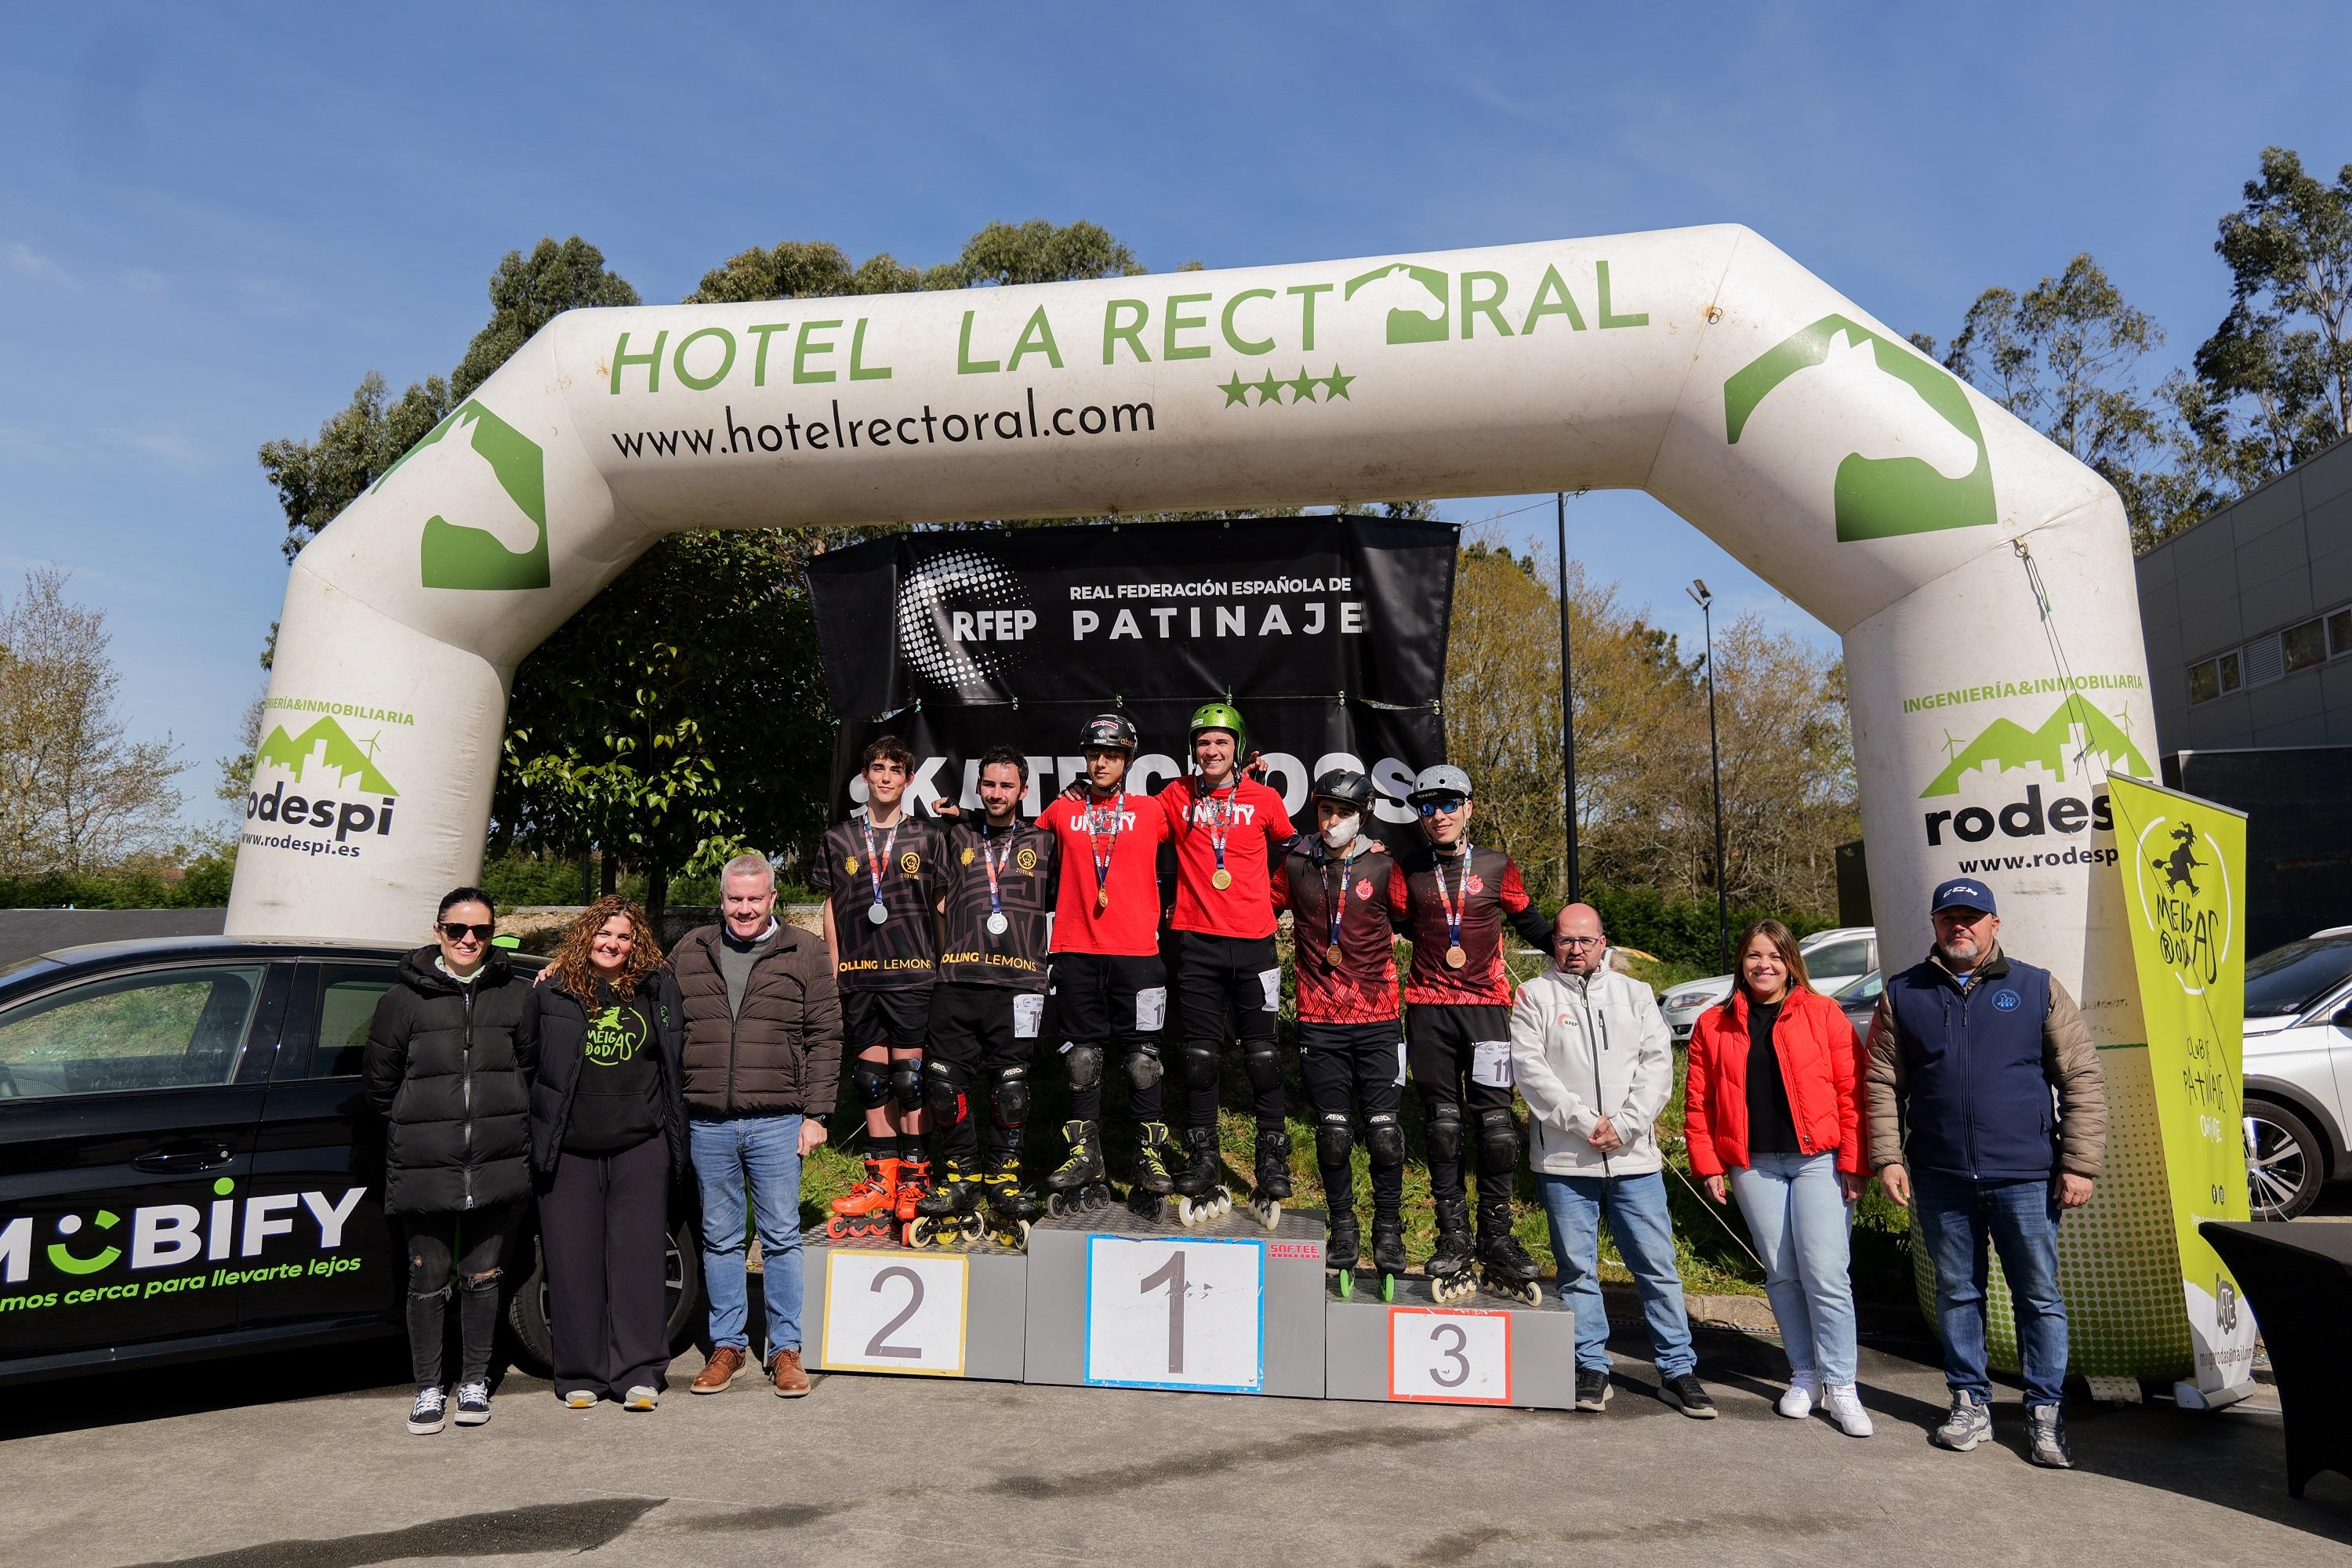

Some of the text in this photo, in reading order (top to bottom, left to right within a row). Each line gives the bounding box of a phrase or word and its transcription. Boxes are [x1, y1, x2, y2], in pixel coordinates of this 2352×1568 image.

[610, 318, 892, 395] HOTEL
[957, 303, 1064, 375] LA
[612, 387, 1155, 459] www.hotelrectoral.com
[1070, 576, 1352, 600] REAL FEDERACIÓN ESPAÑOLA DE
[953, 609, 1037, 641] RFEP
[1073, 602, 1363, 641] PATINAJE
[1903, 675, 2143, 714] INGENIERÍA&INMOBILIARIA
[246, 781, 395, 842] odespi
[1926, 784, 2114, 847] rodes
[1958, 846, 2119, 874] www.rodesp
[837, 959, 879, 972] OLLING
[941, 952, 1036, 972] OLLING LEMONS
[1270, 1244, 1319, 1254] SOFTEE
[64, 1283, 138, 1305] cerca
[144, 1274, 206, 1300] para
[211, 1261, 303, 1288] llevarte
[307, 1254, 362, 1279] lejos
[864, 1266, 923, 1360] 2
[1140, 1250, 1185, 1374] 1
[1428, 1323, 1472, 1388] 3
